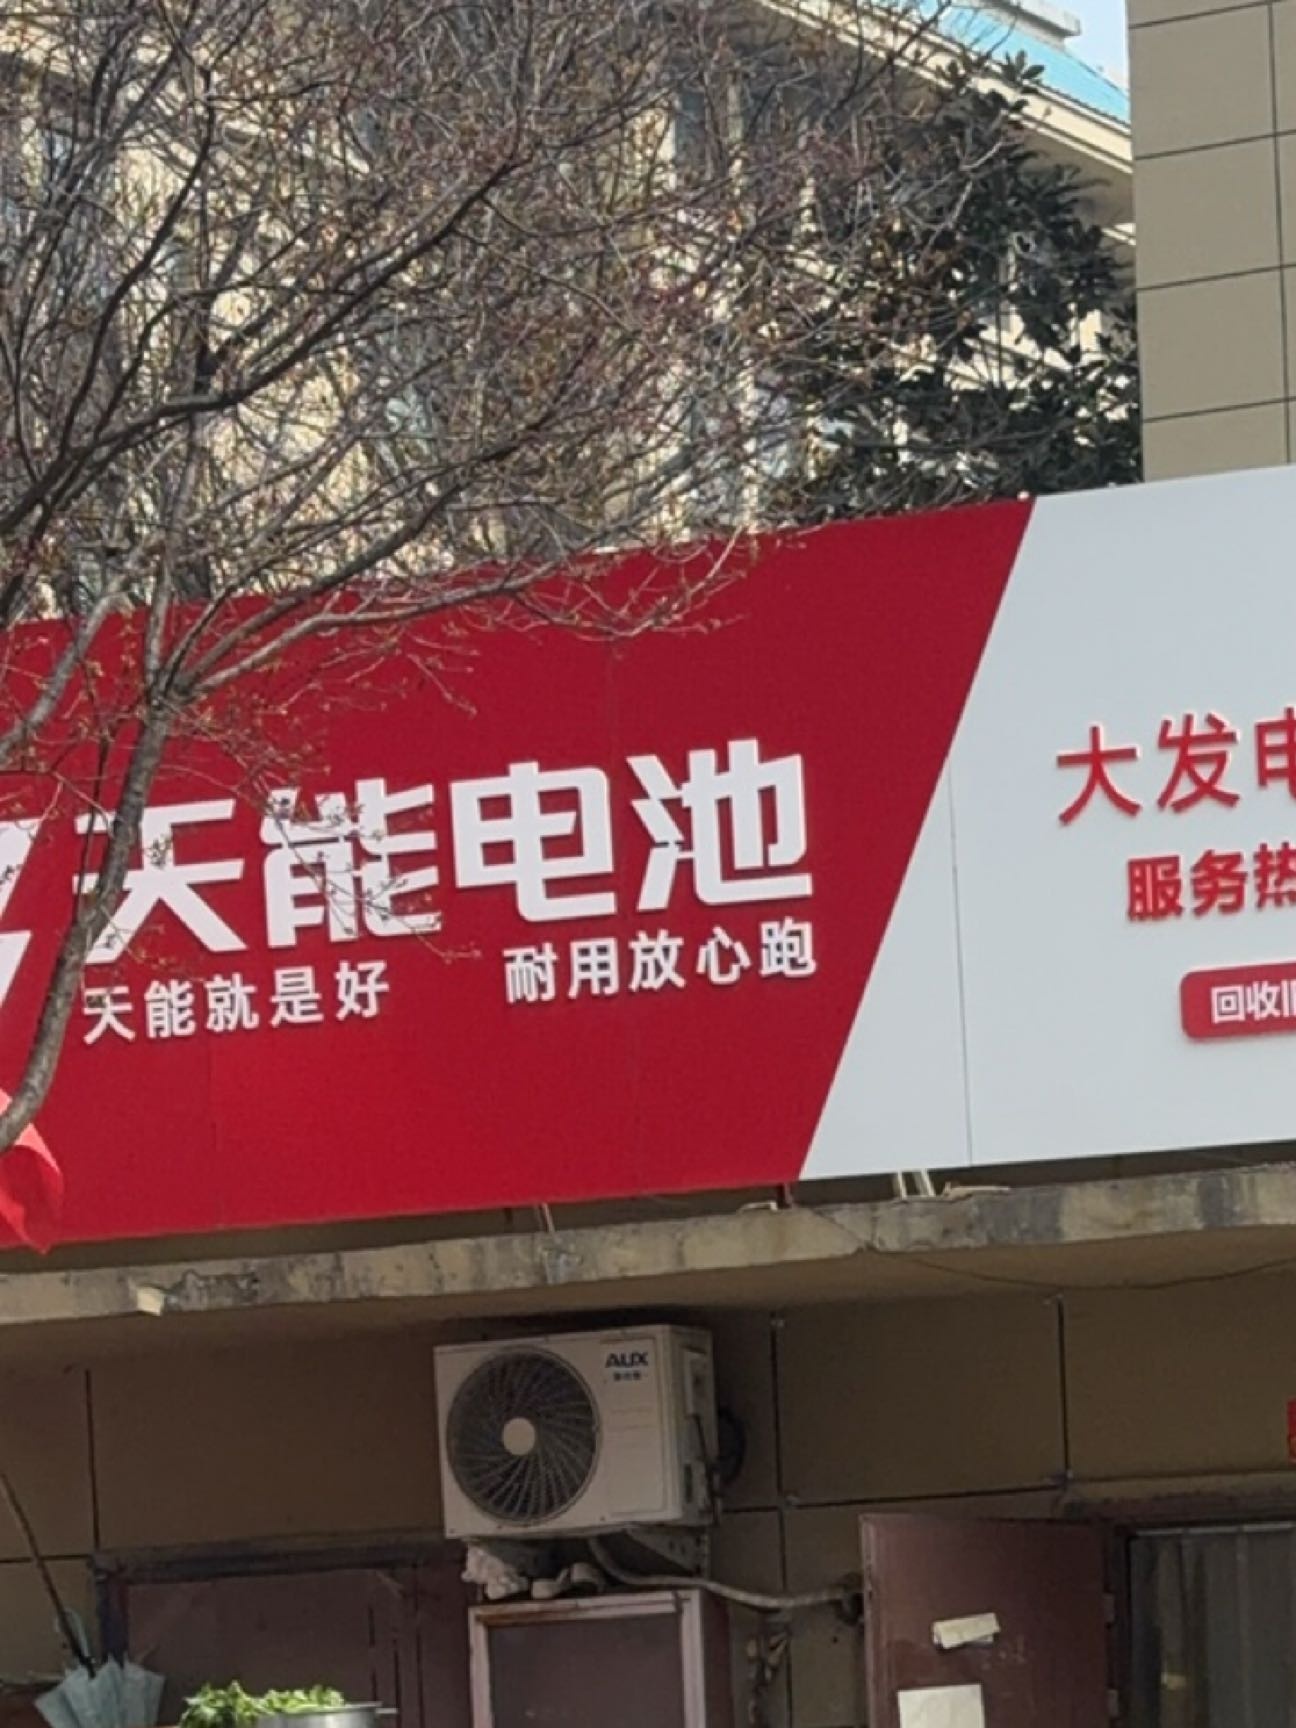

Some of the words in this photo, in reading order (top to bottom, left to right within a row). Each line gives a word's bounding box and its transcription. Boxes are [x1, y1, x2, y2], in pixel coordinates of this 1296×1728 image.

[73, 737, 813, 966] 天能电池
[83, 960, 390, 1045] 天能就是好
[503, 919, 817, 1003] 耐用放心跑
[604, 1351, 648, 1368] AUX
